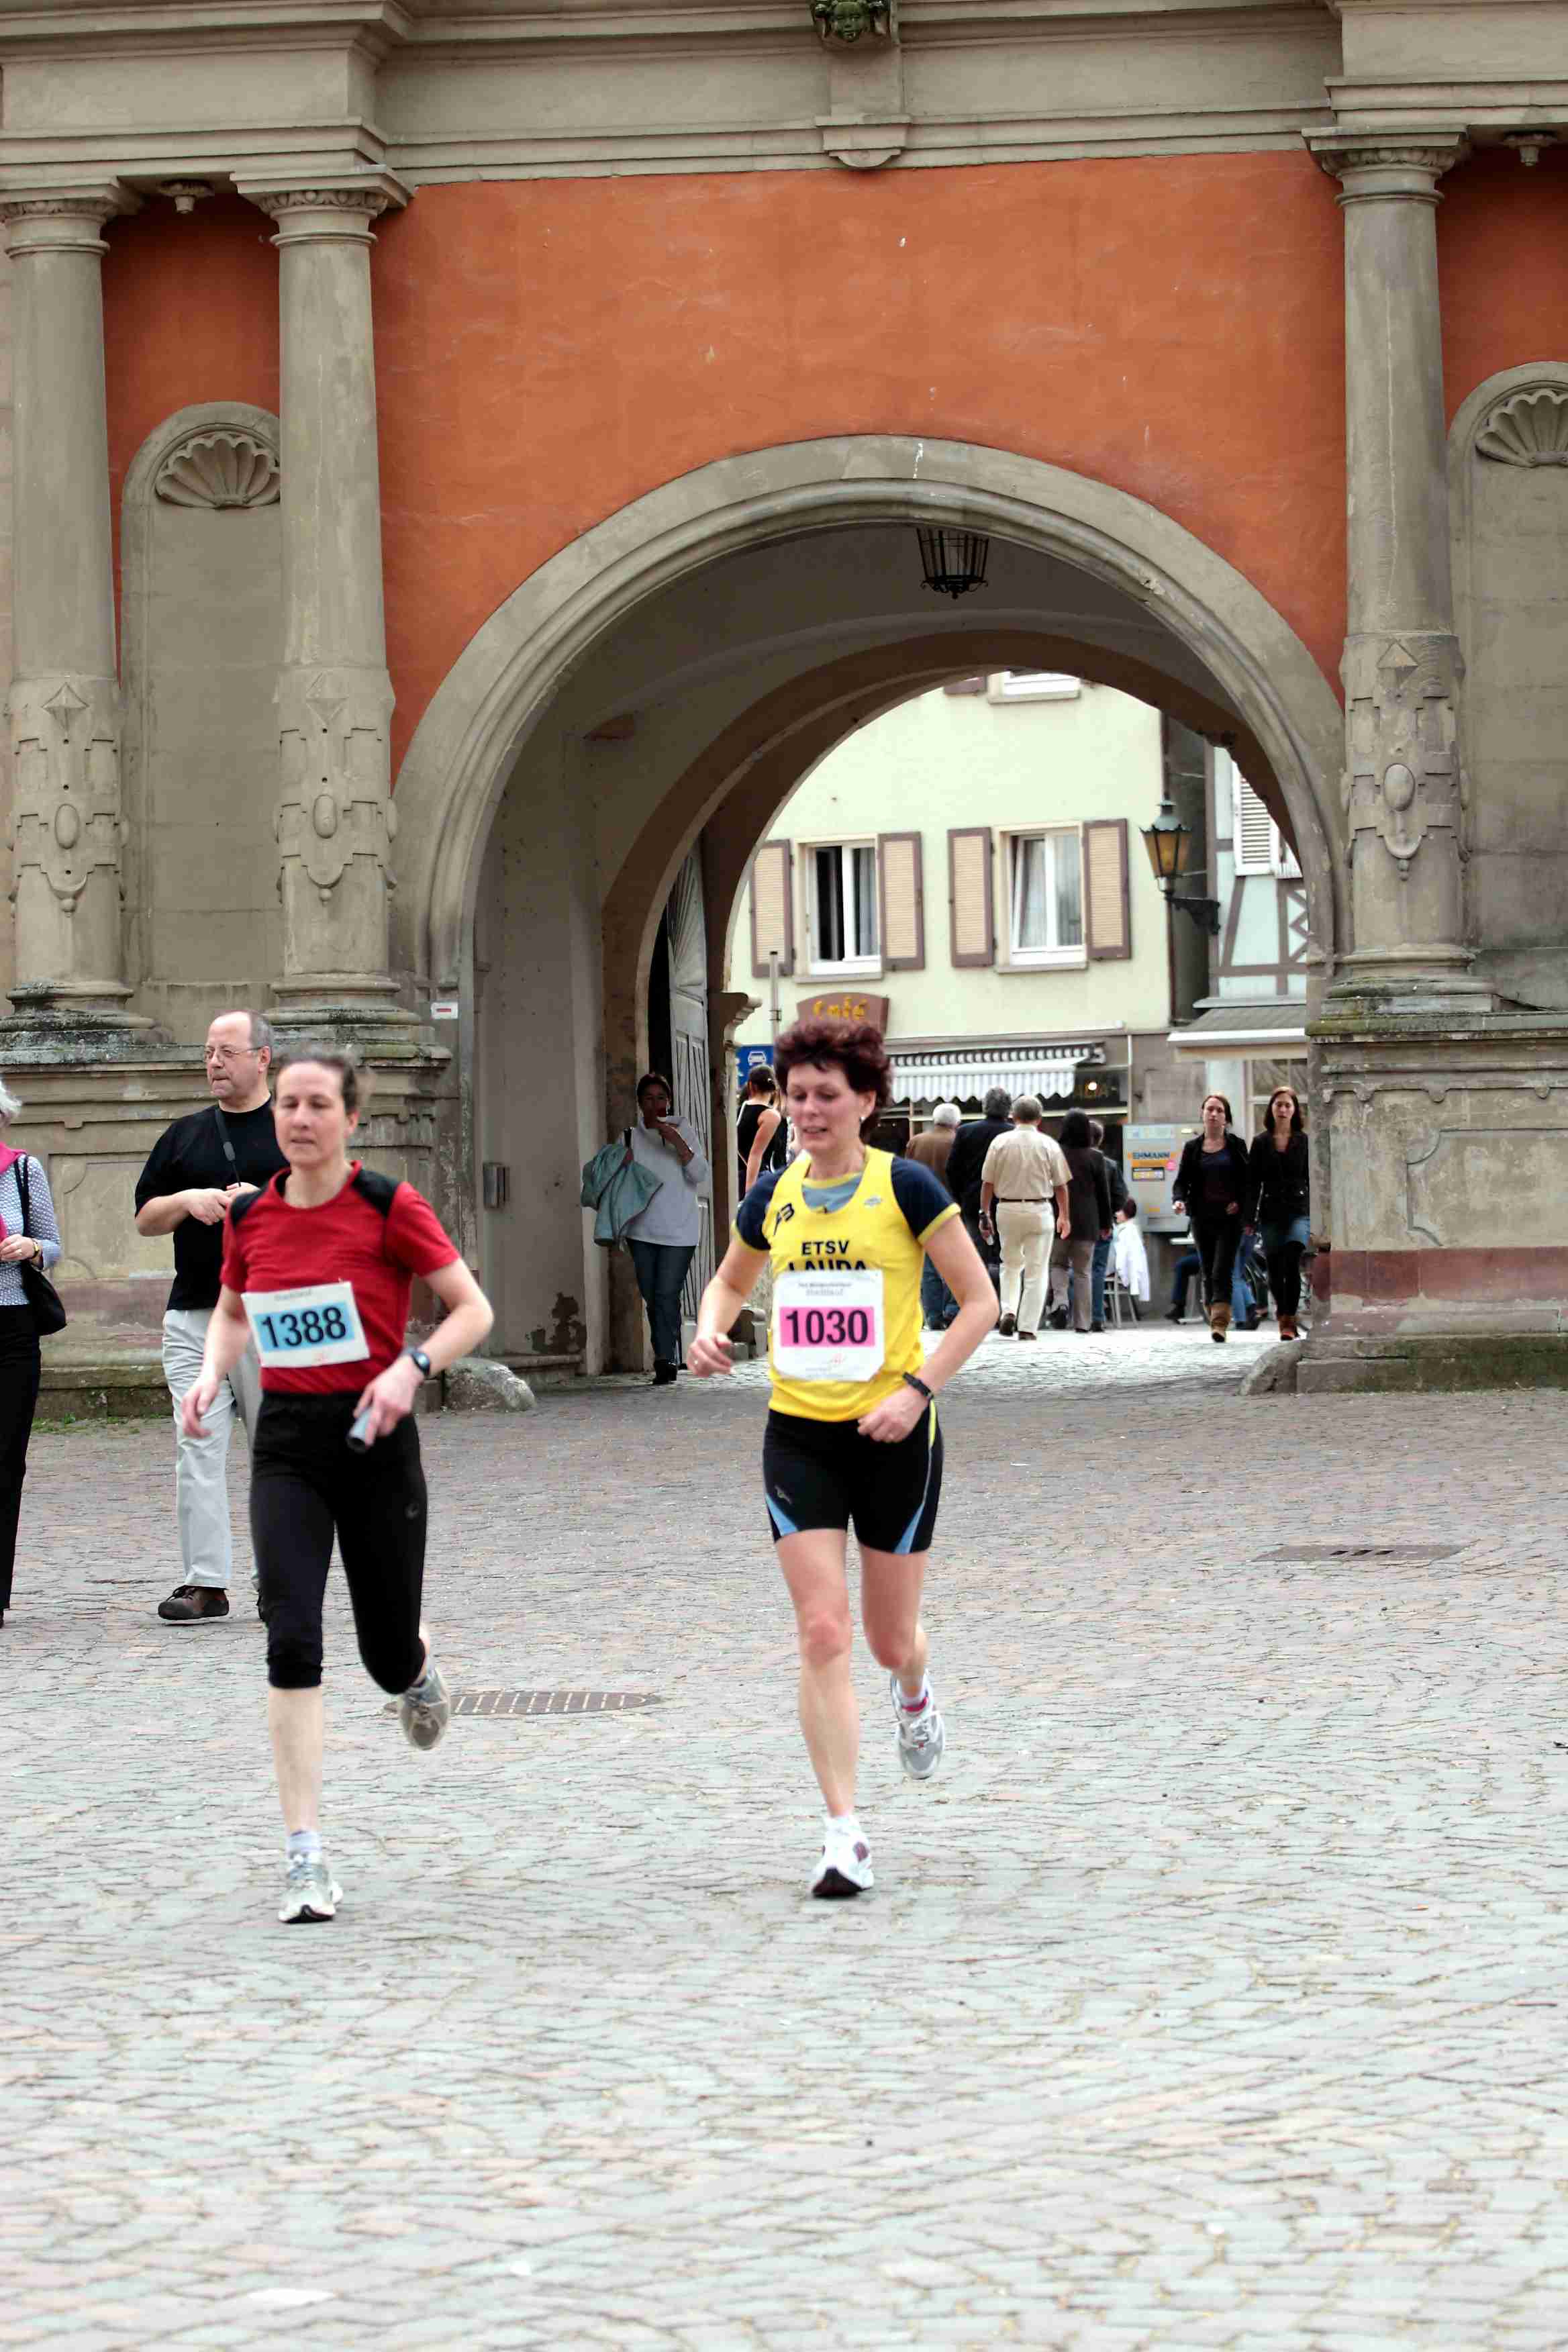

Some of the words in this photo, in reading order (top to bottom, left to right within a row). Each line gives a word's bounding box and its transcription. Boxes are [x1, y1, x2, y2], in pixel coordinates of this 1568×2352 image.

[812, 996, 869, 1020] Café
[801, 1240, 850, 1255] ETSV
[262, 1306, 346, 1349] 1388
[785, 1310, 869, 1344] 1030
